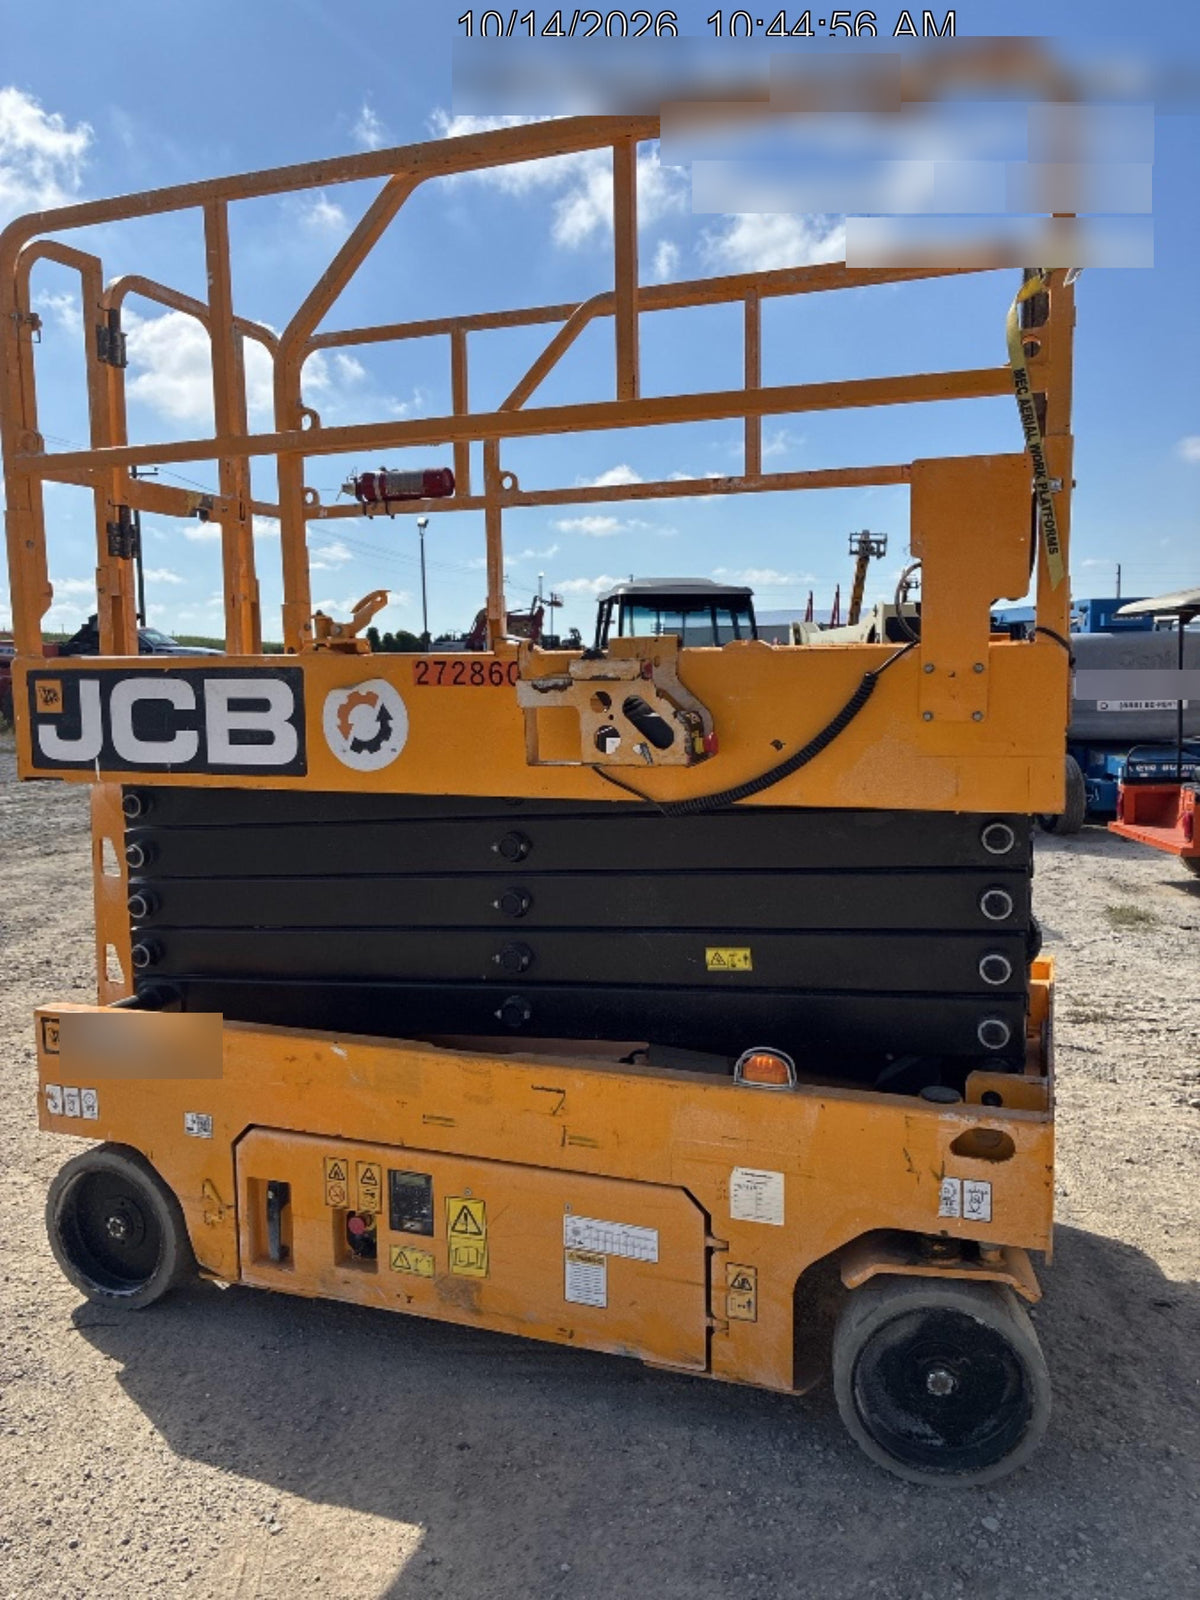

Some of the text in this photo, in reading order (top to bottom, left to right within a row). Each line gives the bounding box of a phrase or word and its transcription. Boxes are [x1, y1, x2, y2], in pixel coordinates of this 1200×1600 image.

[1013, 367, 1058, 555] MEC AERIAL WORK PLATFORMS
[38, 677, 299, 765] JCB
